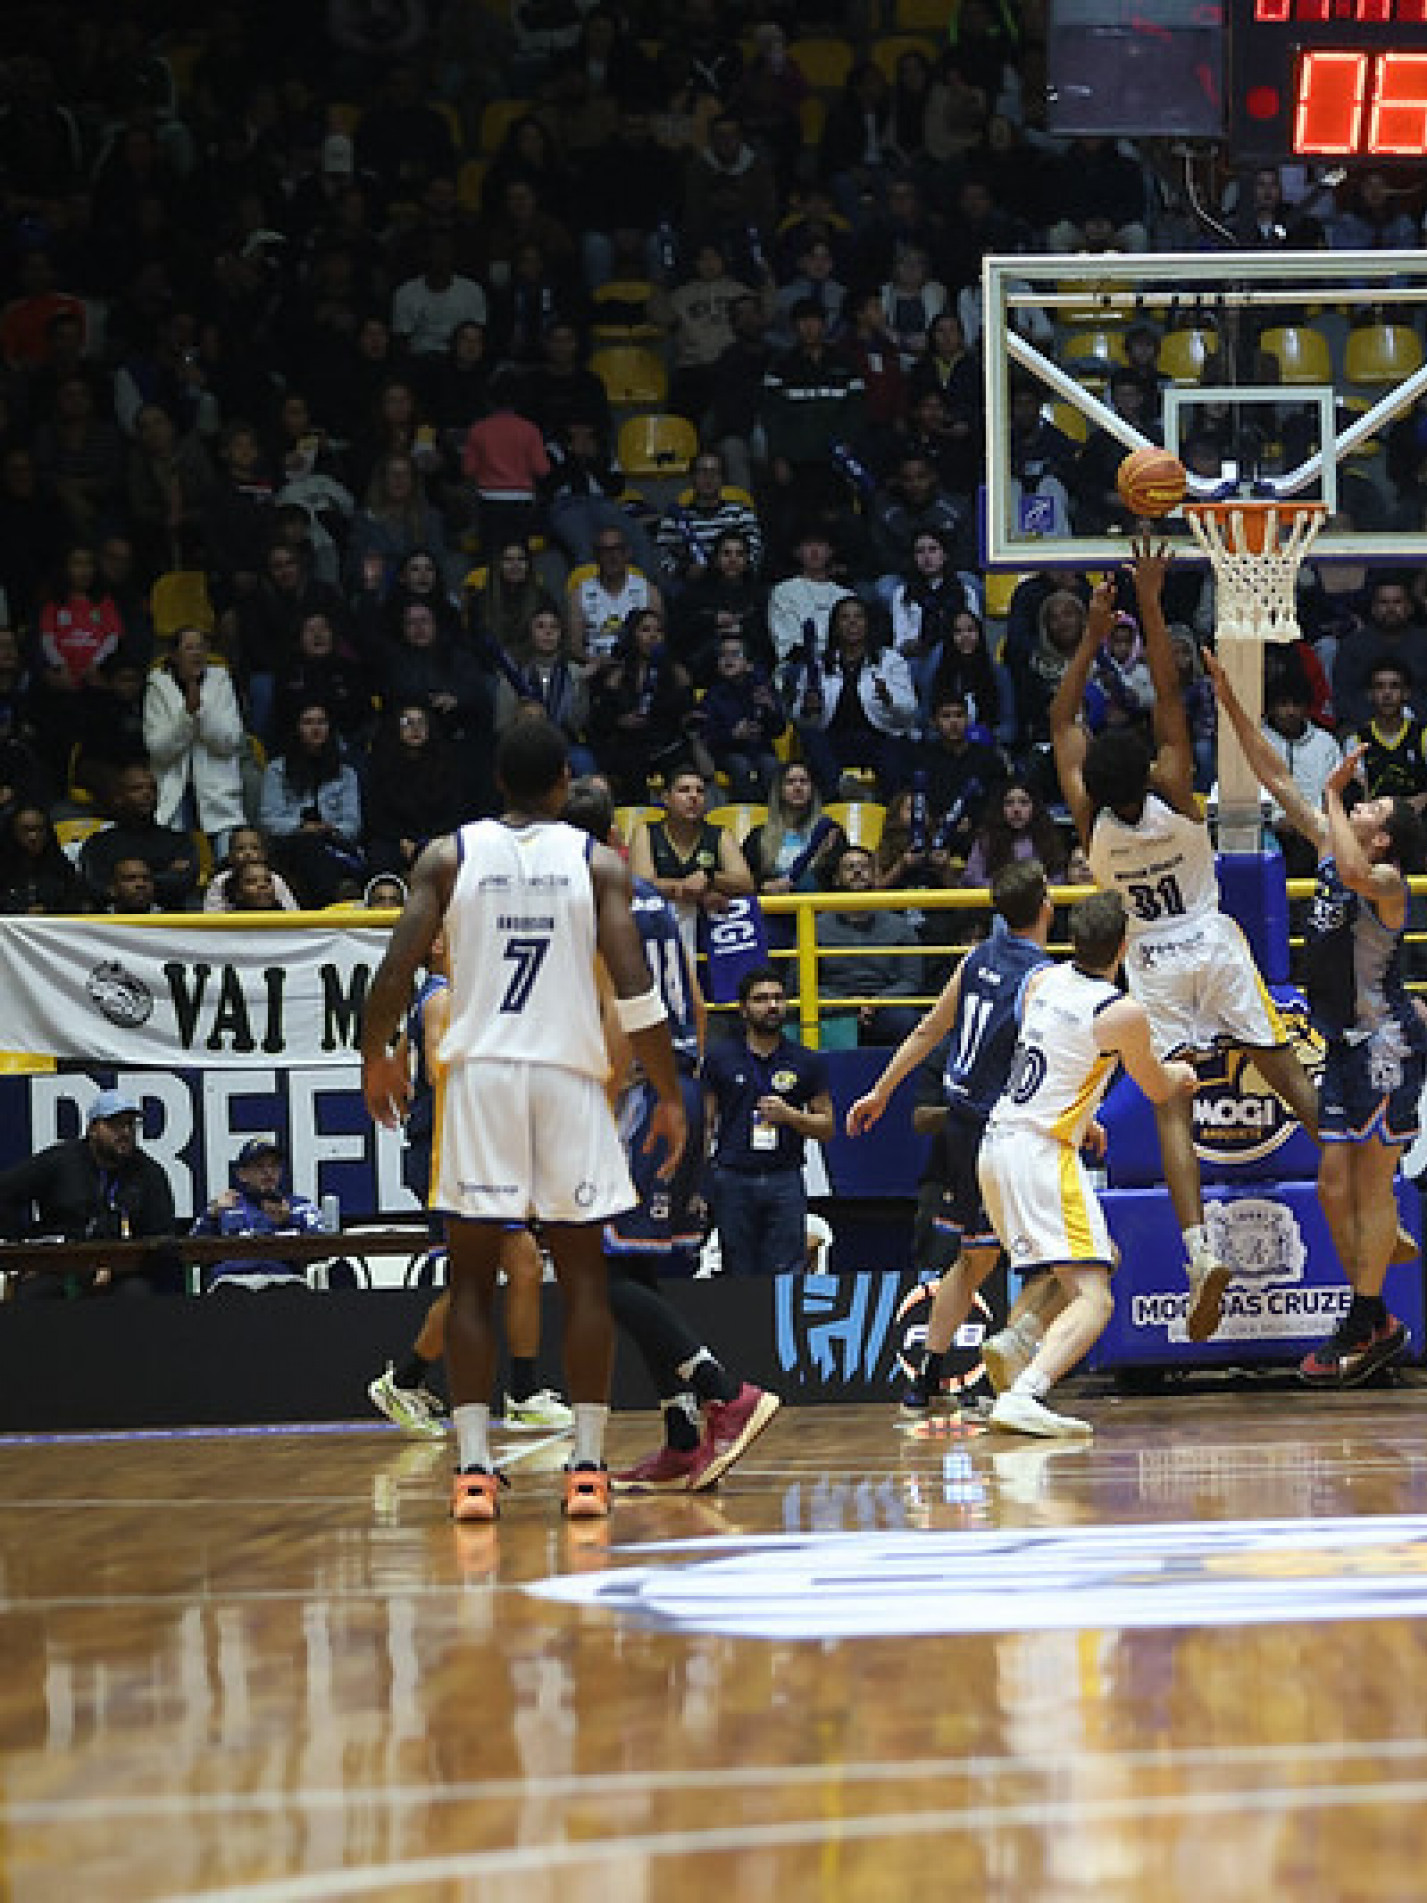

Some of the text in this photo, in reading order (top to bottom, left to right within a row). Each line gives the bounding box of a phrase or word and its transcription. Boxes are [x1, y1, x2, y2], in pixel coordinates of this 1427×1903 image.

[1128, 874, 1187, 921] 31
[164, 962, 286, 1053] VAI
[499, 937, 552, 1016] 7
[954, 991, 995, 1075] 11
[1266, 1290, 1353, 1317] CRUZE
